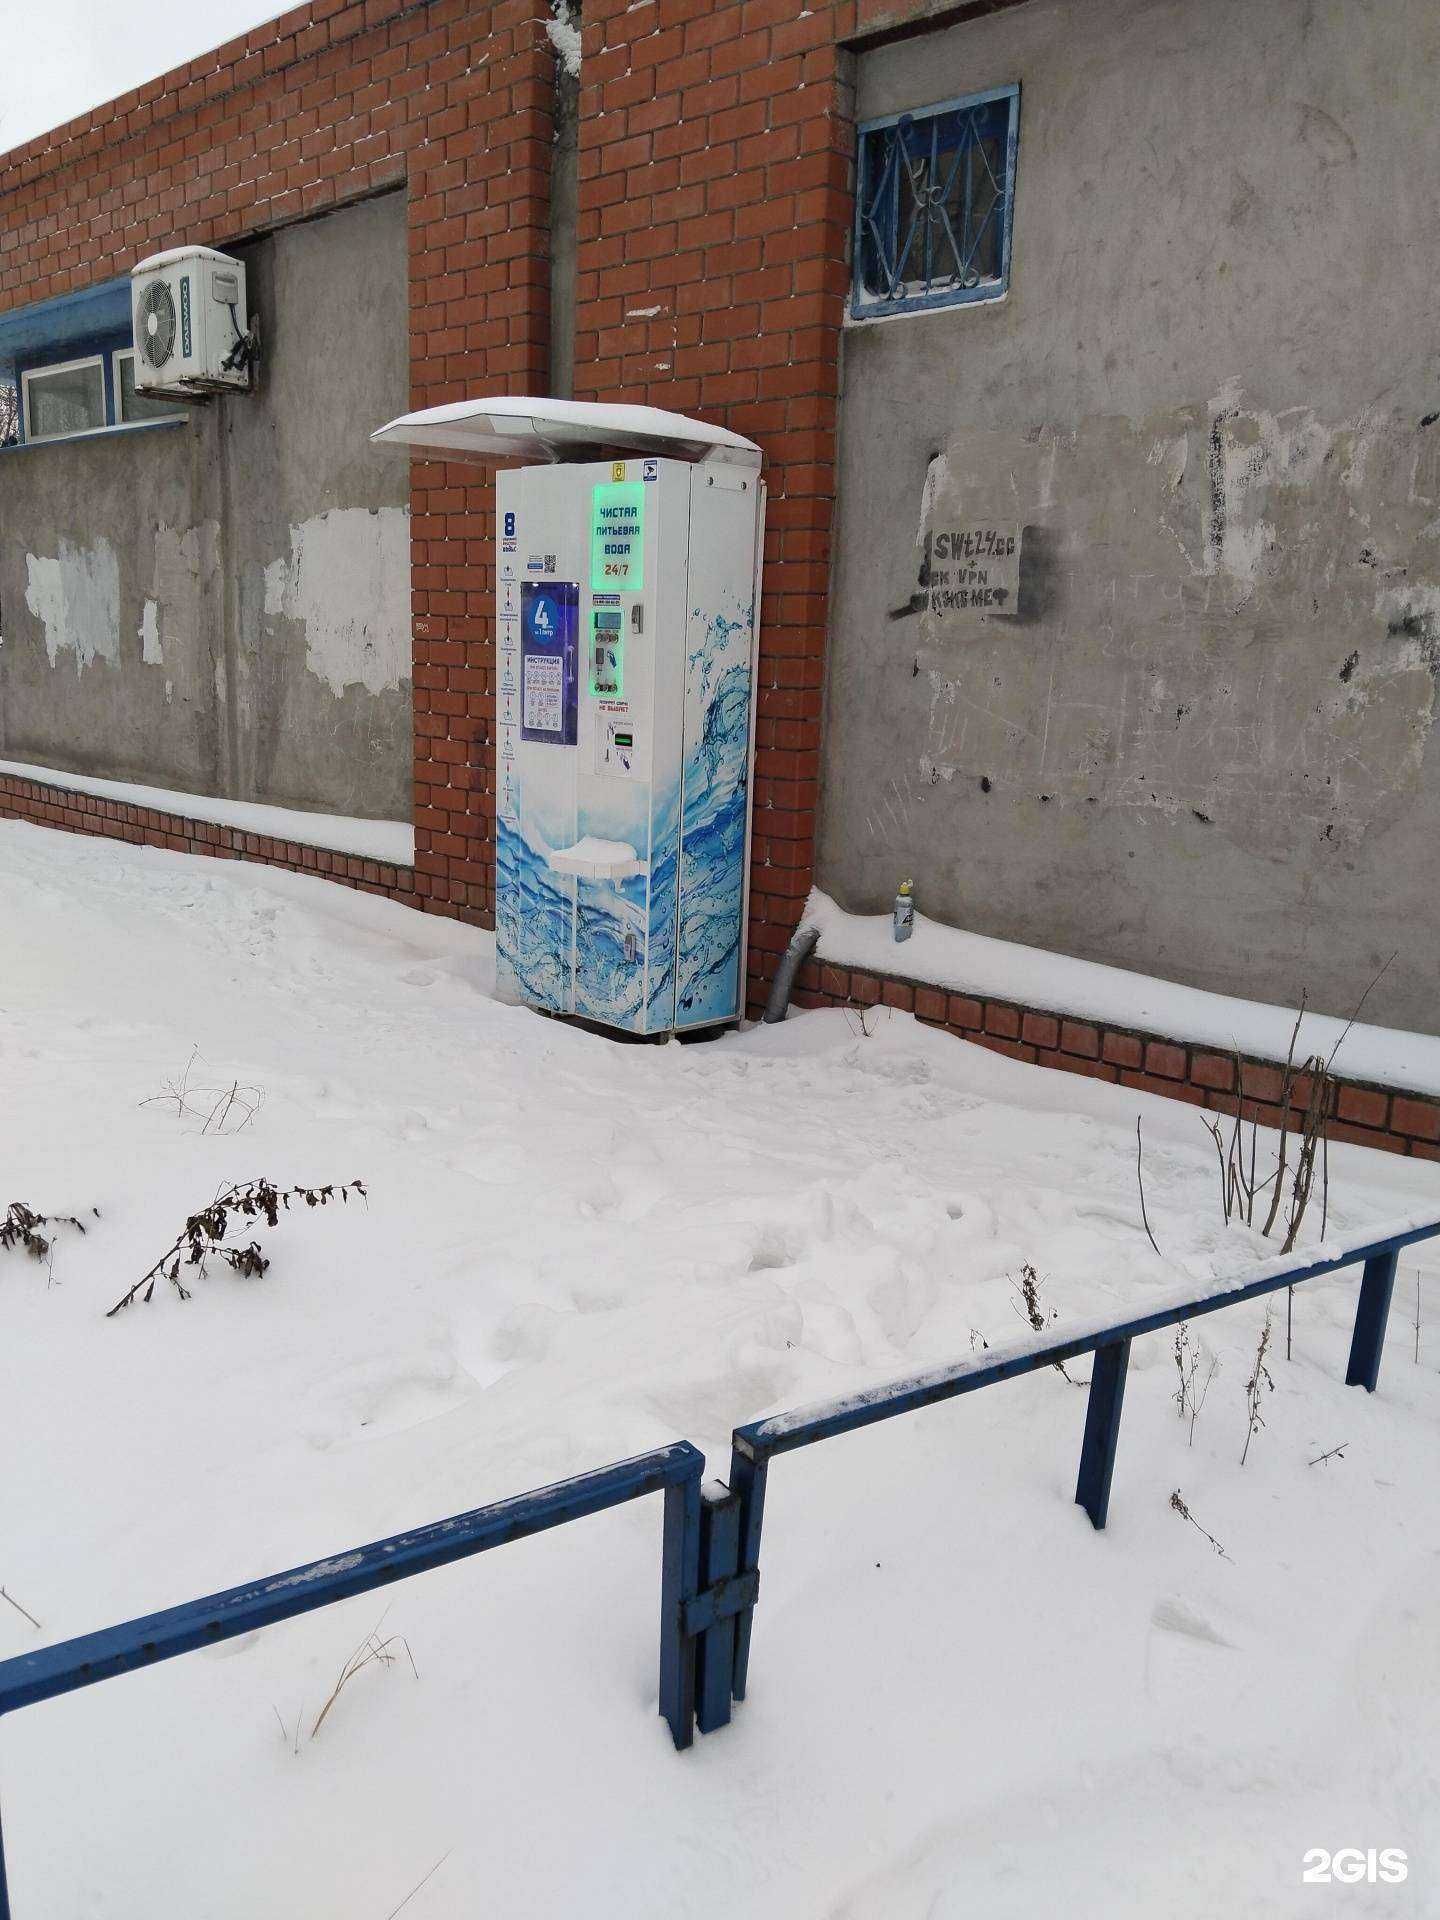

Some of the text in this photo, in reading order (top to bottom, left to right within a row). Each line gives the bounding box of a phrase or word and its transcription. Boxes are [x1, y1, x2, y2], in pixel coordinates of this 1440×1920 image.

[181, 281, 190, 354] DAEWOO
[600, 506, 638, 518] ЧИСТАЯ
[504, 512, 515, 537] 8
[596, 526, 640, 536] ПИТЬЕВАЯ
[604, 544, 631, 555] ВОДА
[604, 564, 629, 576] 24/7
[958, 568, 988, 585] VPN
[534, 600, 548, 629] 4
